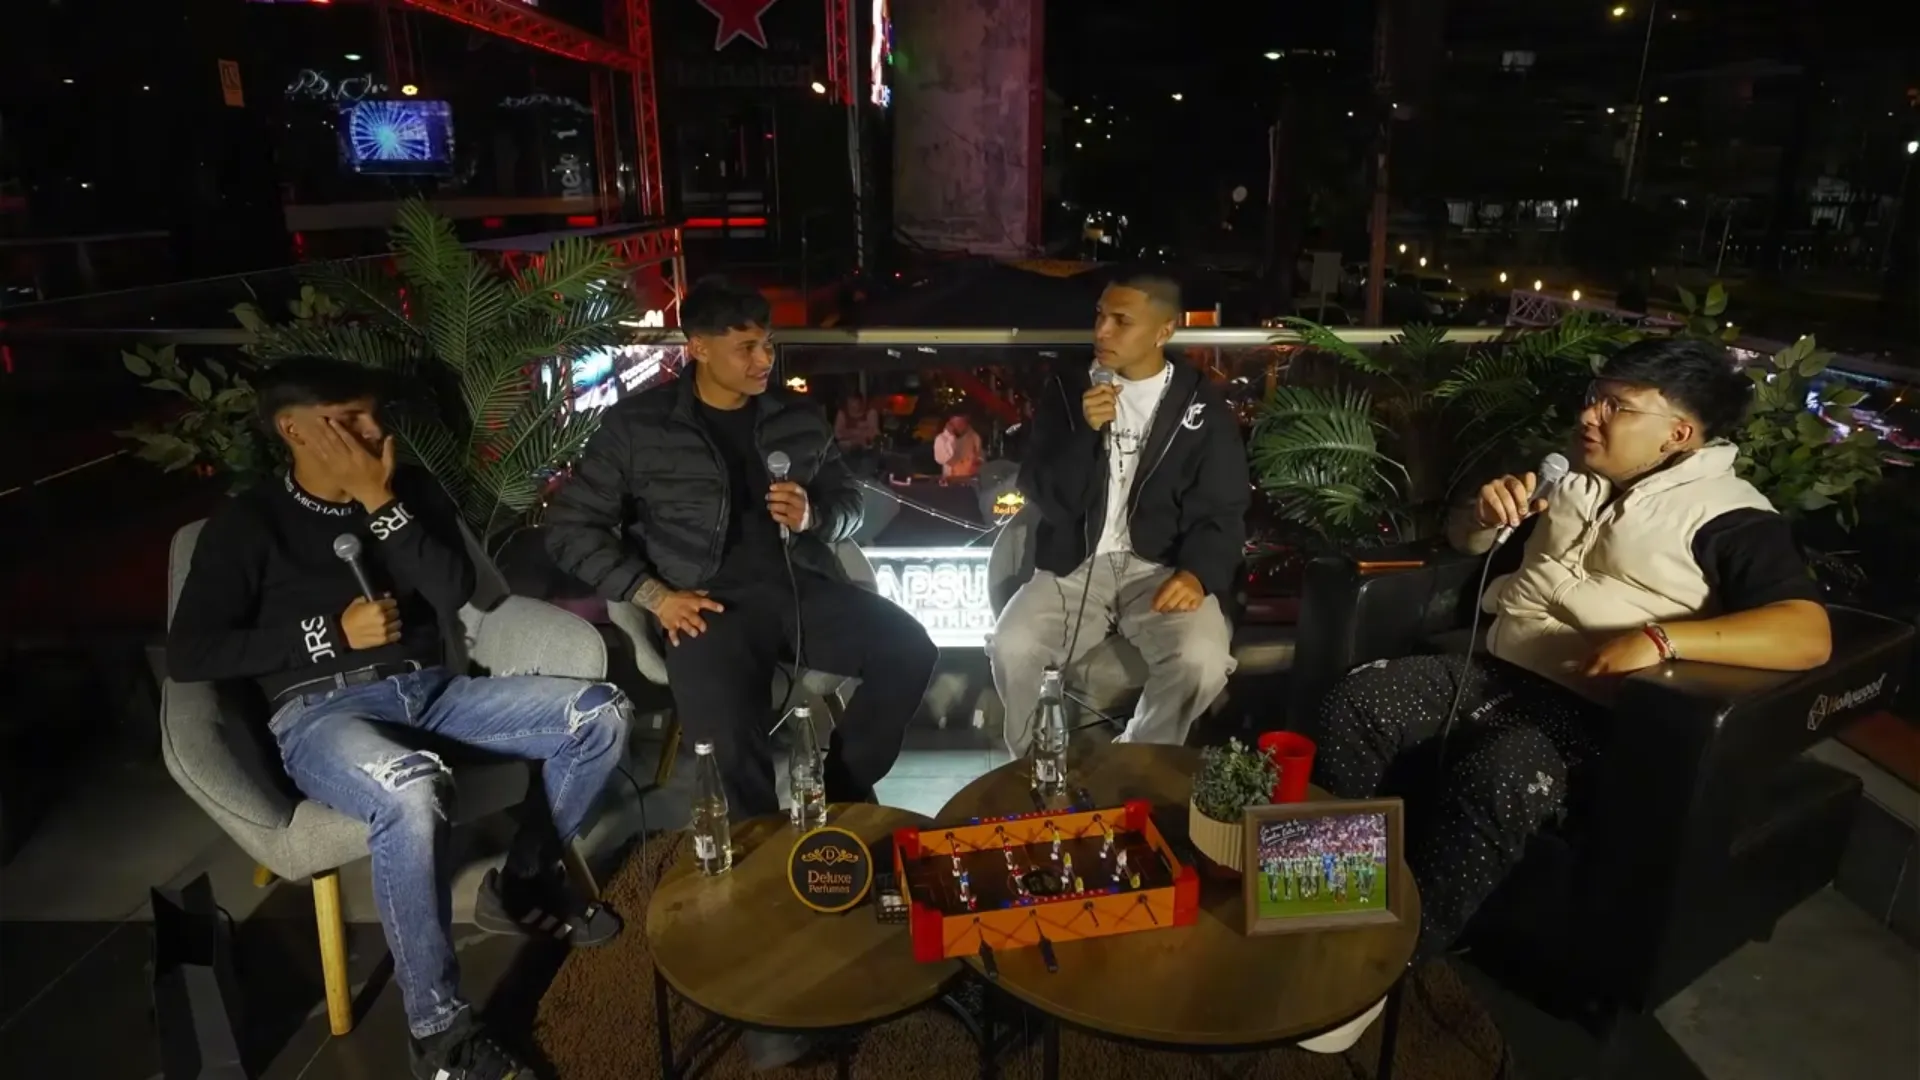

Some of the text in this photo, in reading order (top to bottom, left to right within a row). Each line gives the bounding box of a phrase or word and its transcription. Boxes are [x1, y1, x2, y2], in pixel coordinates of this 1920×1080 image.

[825, 849, 836, 861] D
[807, 869, 852, 884] Deluxe
[807, 884, 851, 894] Perfumes
